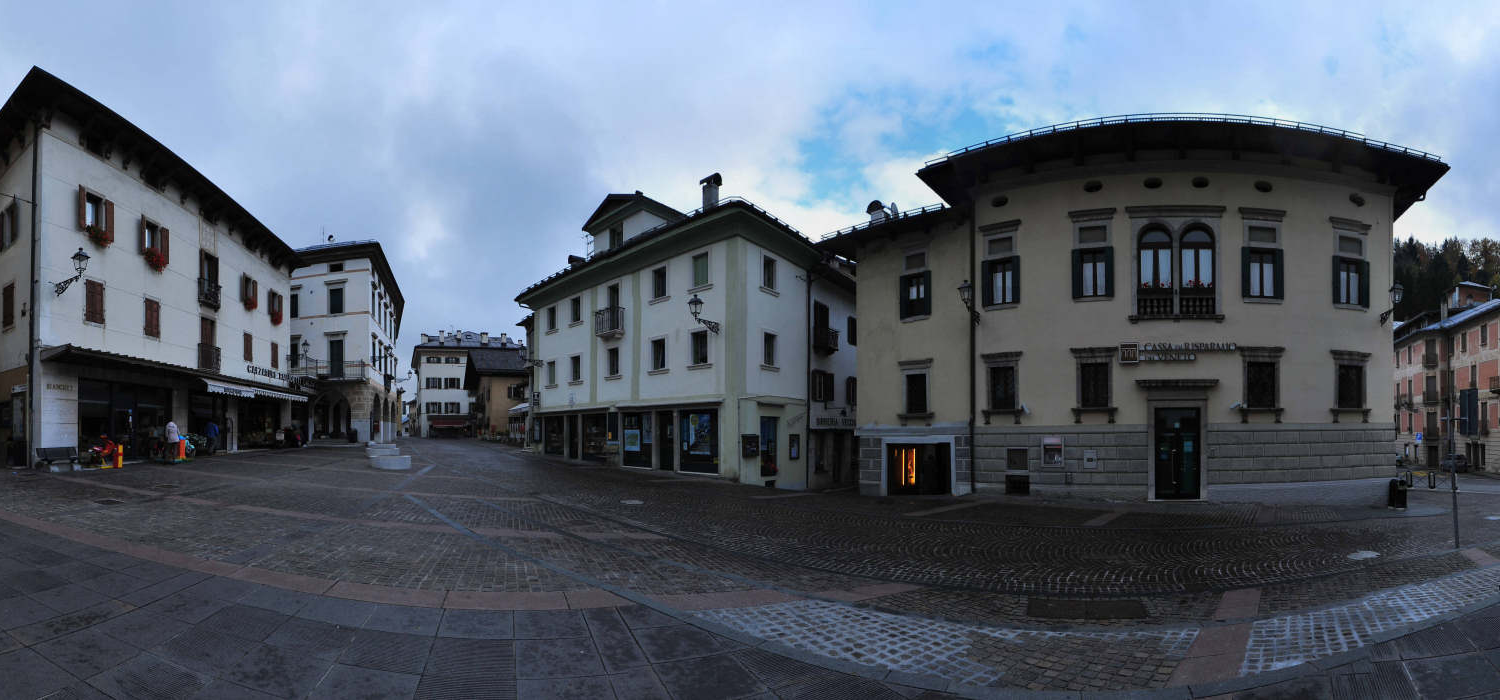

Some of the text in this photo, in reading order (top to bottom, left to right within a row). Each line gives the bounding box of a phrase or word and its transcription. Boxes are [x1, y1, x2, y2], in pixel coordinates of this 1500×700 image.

[1144, 342, 1173, 351] CASSA
[1184, 342, 1237, 352] RISPARMIO
[1158, 352, 1197, 361] VENETO
